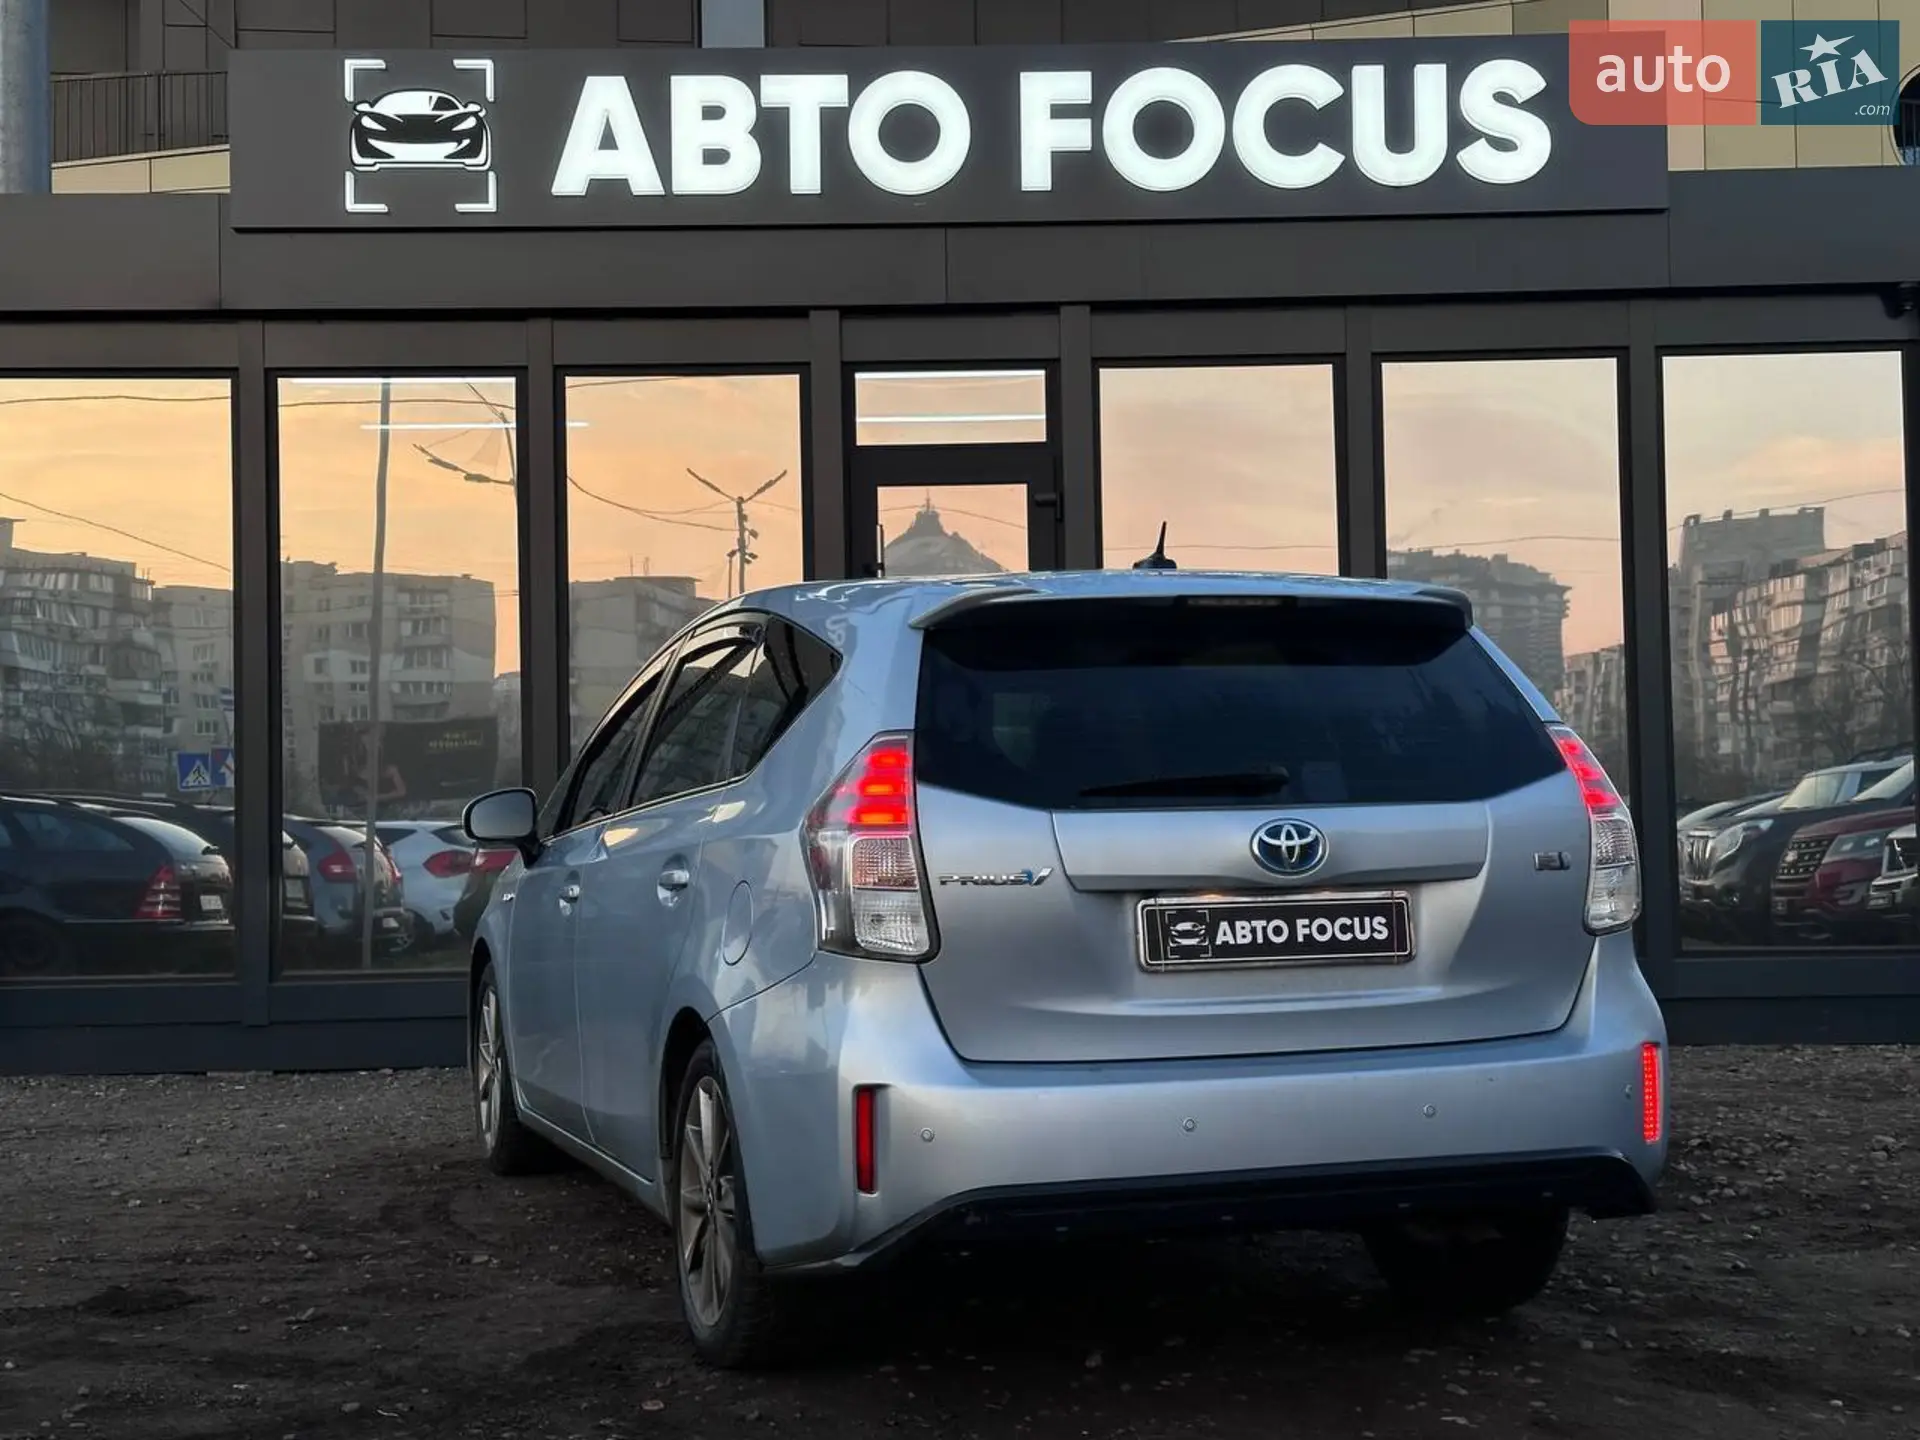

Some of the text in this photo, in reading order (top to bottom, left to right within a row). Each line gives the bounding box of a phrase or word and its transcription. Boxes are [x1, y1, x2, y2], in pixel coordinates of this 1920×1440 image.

[551, 59, 1552, 196] АВТО FOCUS
[939, 873, 1025, 886] PRIUS
[1215, 916, 1389, 945] АВТО FOCUS
